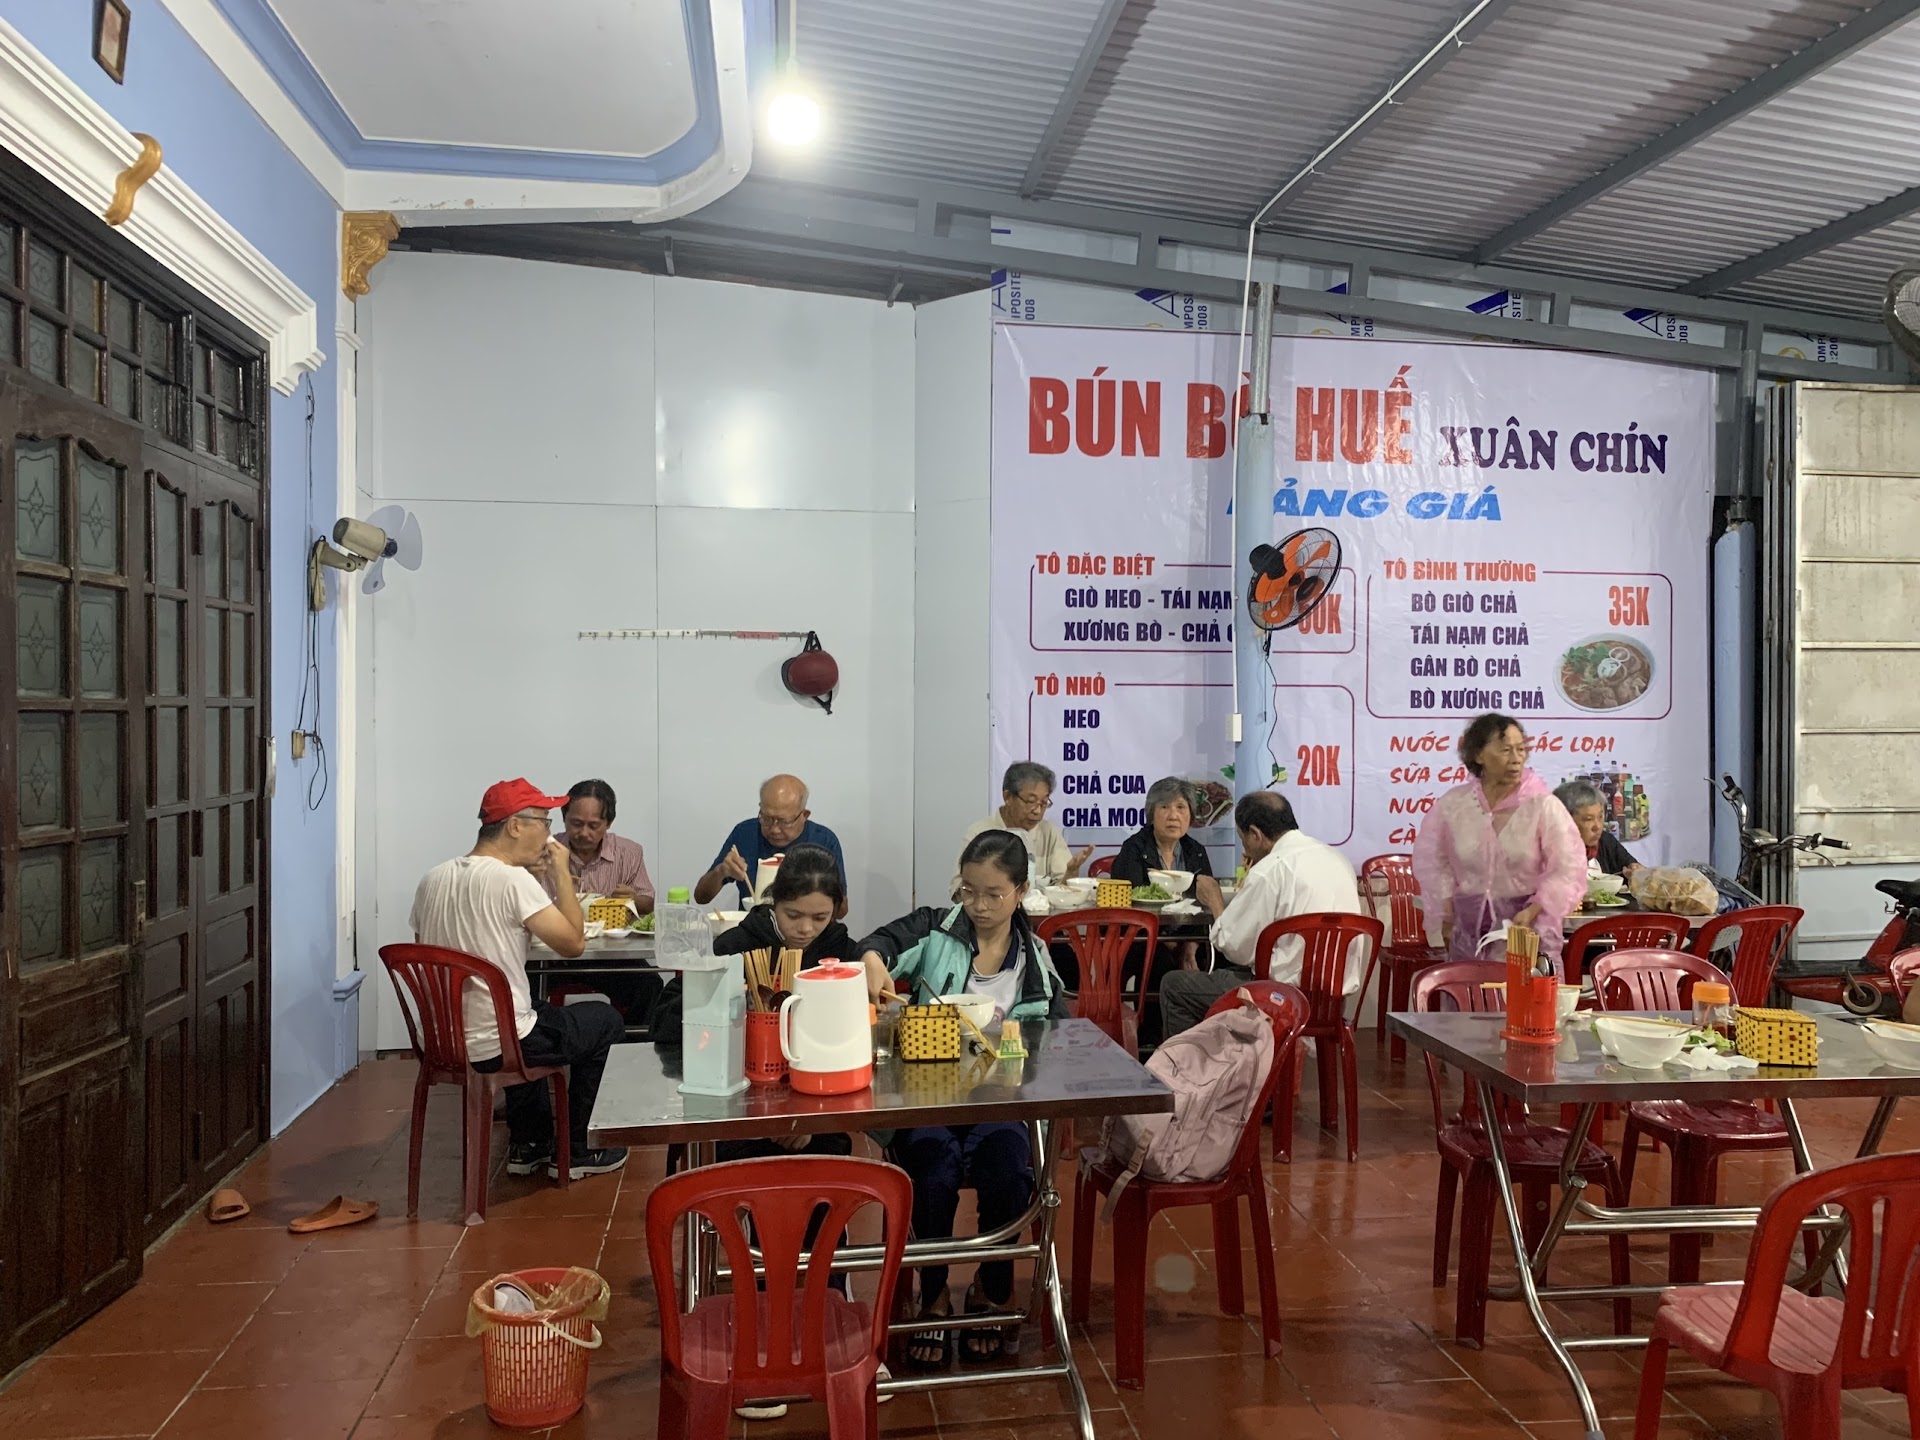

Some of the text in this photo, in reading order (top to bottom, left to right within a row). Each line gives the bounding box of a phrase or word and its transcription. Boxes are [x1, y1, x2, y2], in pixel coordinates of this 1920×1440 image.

[1010, 271, 1021, 319] POSITE
[1197, 305, 1208, 330] 008
[1350, 315, 1361, 337] MP
[1029, 365, 1668, 475] BÚN B HUẾ XUÂN CHÍN
[1226, 478, 1502, 521] ẢNG GIÁ
[1036, 552, 1156, 580] TÔ ĐẶC BIỆT
[1384, 557, 1536, 583] TÔ BÌNH THƯỜNG
[1065, 588, 1098, 608] GIÒ
[1105, 589, 1142, 609] HEO
[1161, 586, 1191, 610] TÁI
[1411, 590, 1518, 614] BÒ GIÒ CHẢ
[1608, 585, 1650, 627] 35K
[1064, 618, 1129, 642] XƯƠNG
[1136, 620, 1162, 642] BÒ
[1182, 620, 1222, 643] CHẢ
[1411, 622, 1529, 649] TÁI NẠM CHẢ
[1410, 654, 1521, 678] GÂN BÒ CHẢ
[1035, 672, 1106, 696] TÔ NHỎ
[1410, 686, 1545, 710] BÒ XƯƠNG CHẢ
[1064, 709, 1100, 729] HEO
[1063, 738, 1089, 762] BÒ
[1389, 731, 1450, 753] NƯỚC
[1523, 731, 1564, 753] CÁC
[1570, 736, 1615, 757] LOẠI
[1297, 744, 1341, 787] 20K
[1389, 762, 1431, 784] SỮA
[1062, 770, 1146, 795] CHẢ CUA
[1062, 802, 1102, 827] CHẢ
[1389, 792, 1438, 814] NƯỚ
